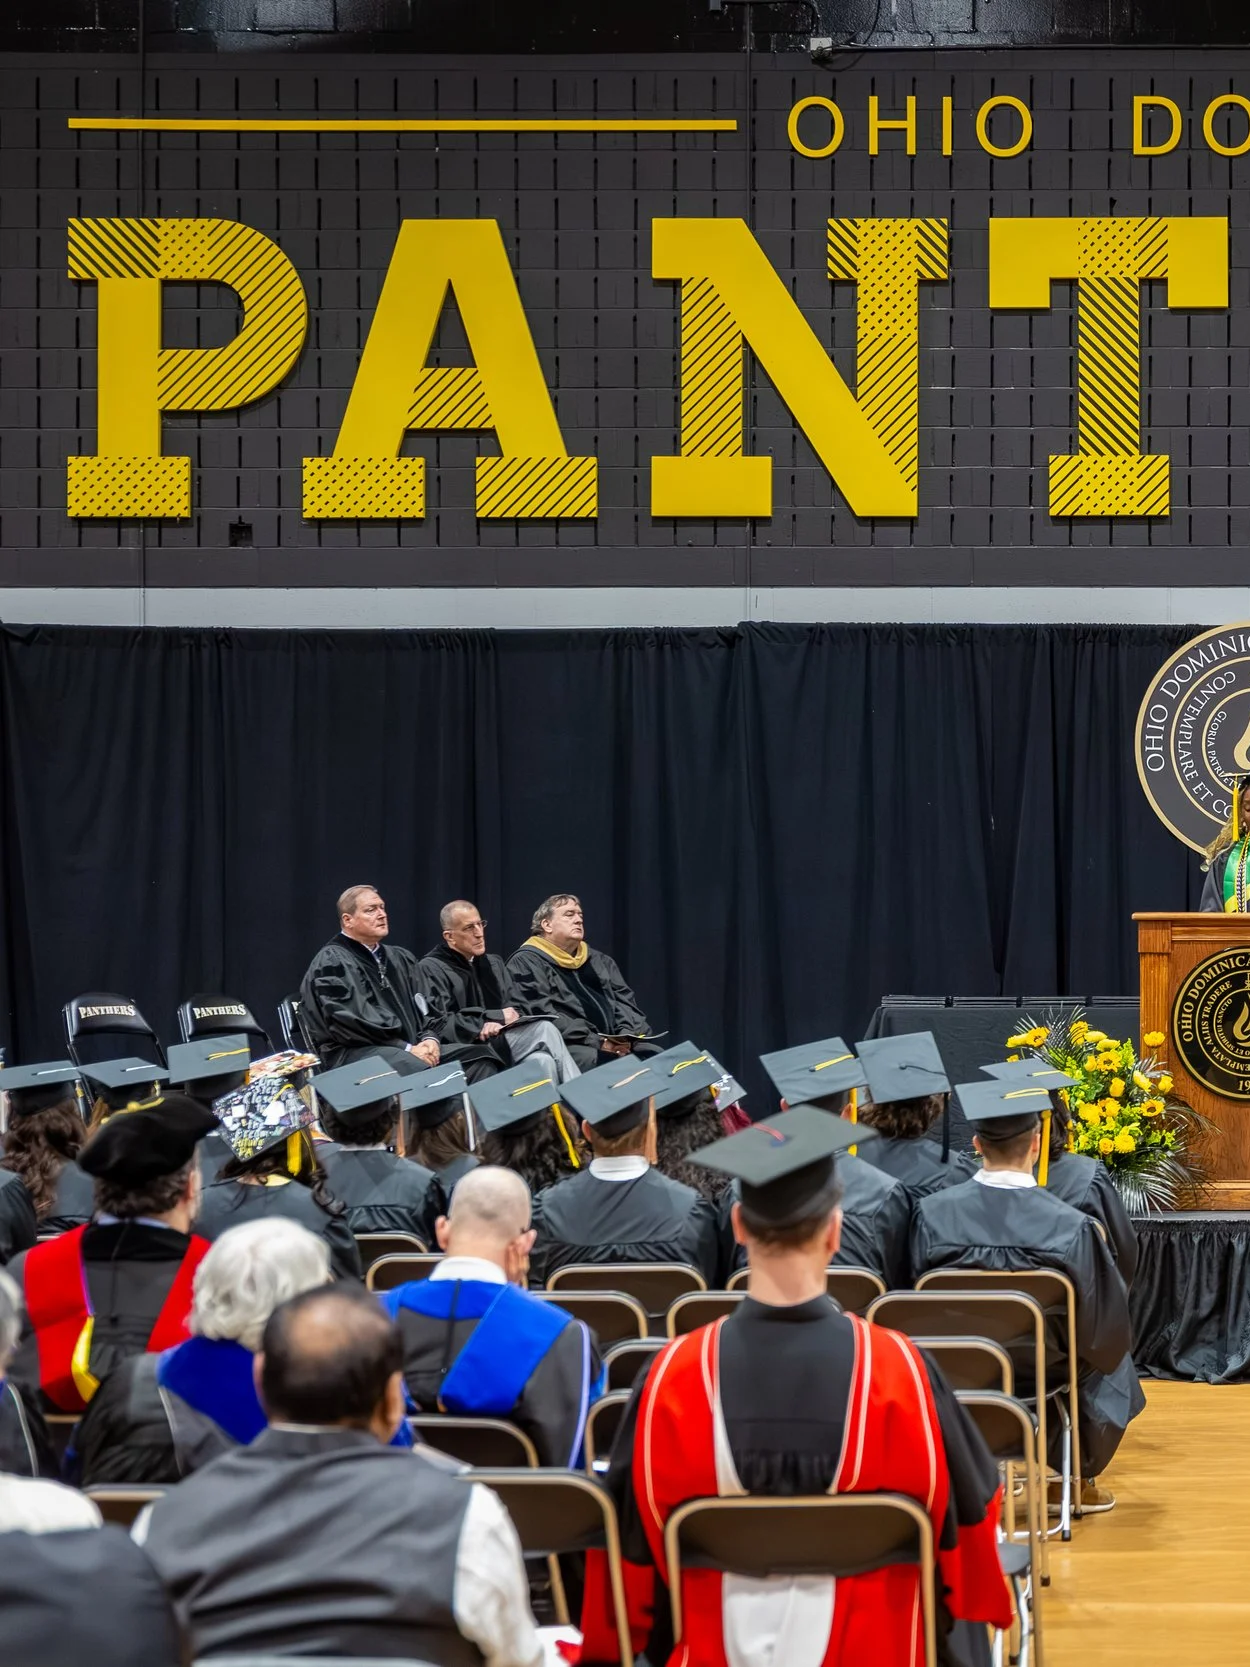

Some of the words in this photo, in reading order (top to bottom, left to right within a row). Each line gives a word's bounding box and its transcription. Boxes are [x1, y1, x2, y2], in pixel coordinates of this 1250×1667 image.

[787, 95, 1033, 158] OHIO
[1145, 704, 1168, 772] OHIO
[1178, 671, 1236, 781] CONTEMPLARE
[1207, 711, 1227, 747] GLORIA
[1192, 782, 1213, 801] ET
[78, 1004, 136, 1019] PANTHERS
[192, 1004, 247, 1020] PANTHERS
[1202, 981, 1232, 1019] TRADERE
[1217, 998, 1233, 1023] SANCTO
[1181, 1002, 1194, 1042] OHIO
[1201, 1020, 1214, 1046] ALIIS
